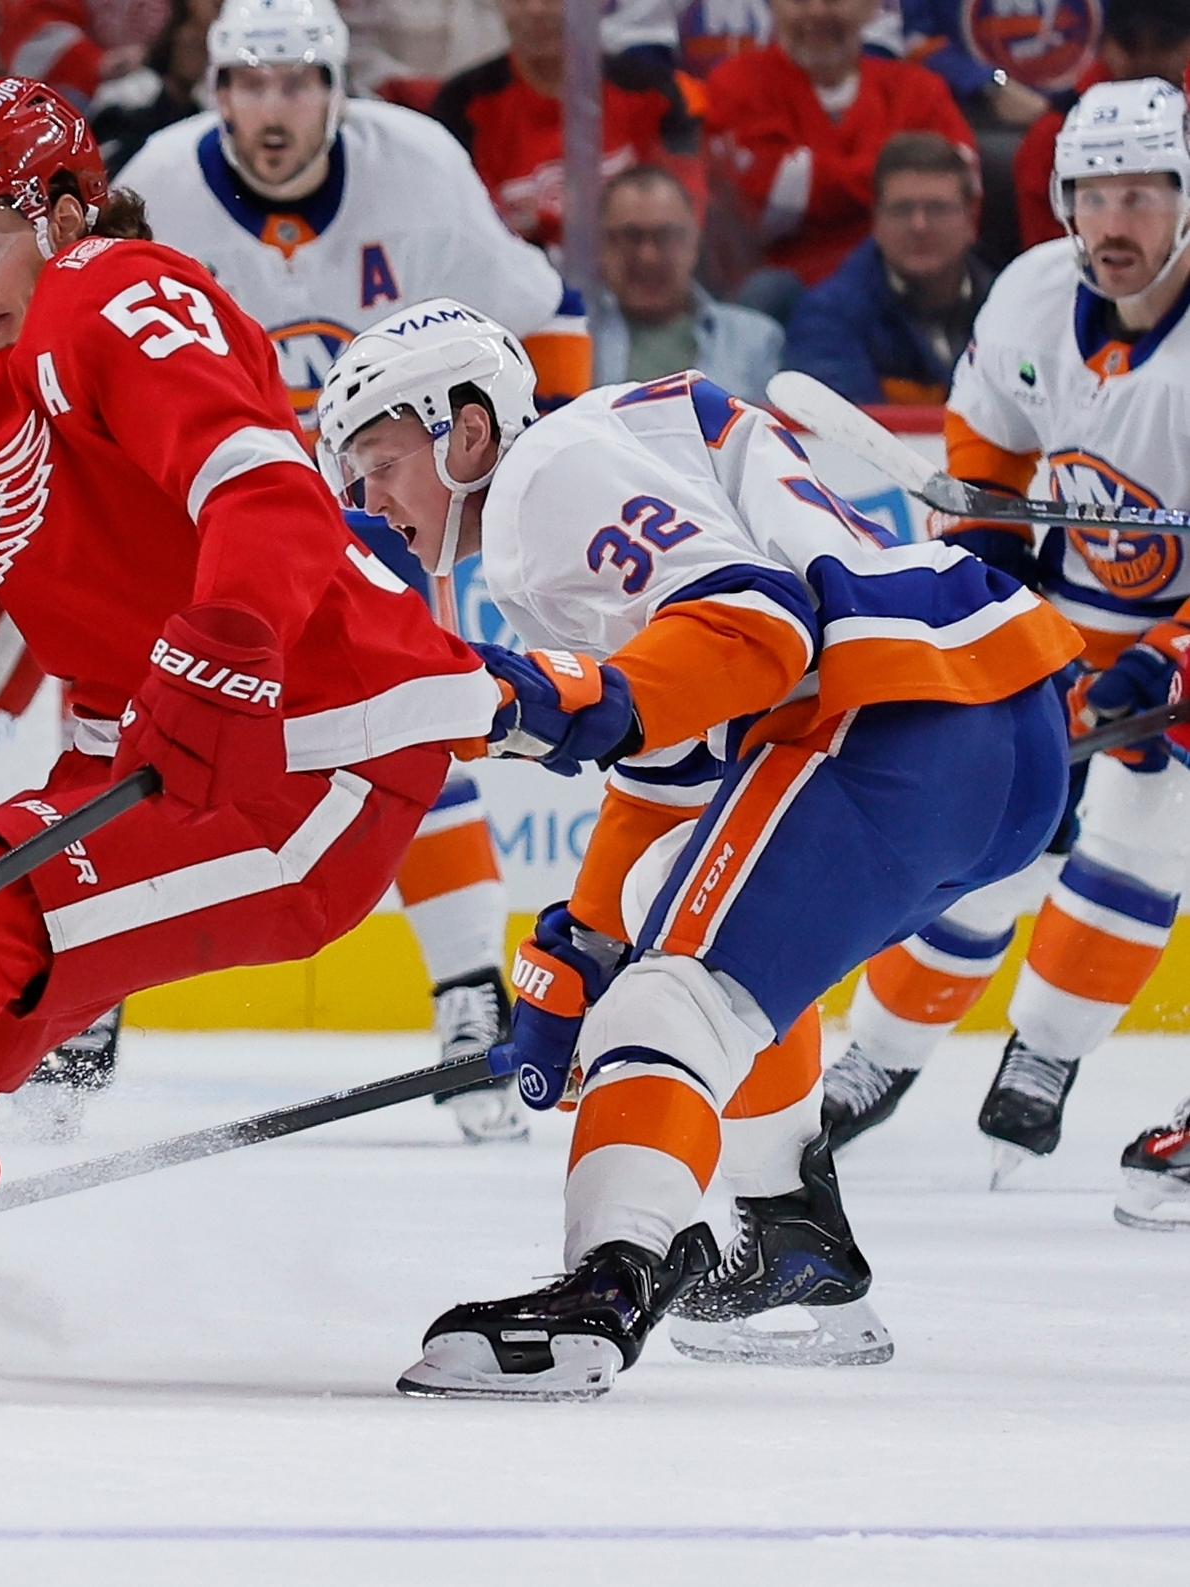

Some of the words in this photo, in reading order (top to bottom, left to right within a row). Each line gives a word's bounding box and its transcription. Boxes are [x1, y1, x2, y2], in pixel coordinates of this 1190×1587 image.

[360, 244, 399, 309] A
[100, 276, 230, 359] 53
[386, 309, 467, 336] VIAM
[37, 352, 72, 417] A
[586, 494, 703, 596] 32
[150, 638, 282, 709] BAUER
[689, 841, 735, 916] CCM
